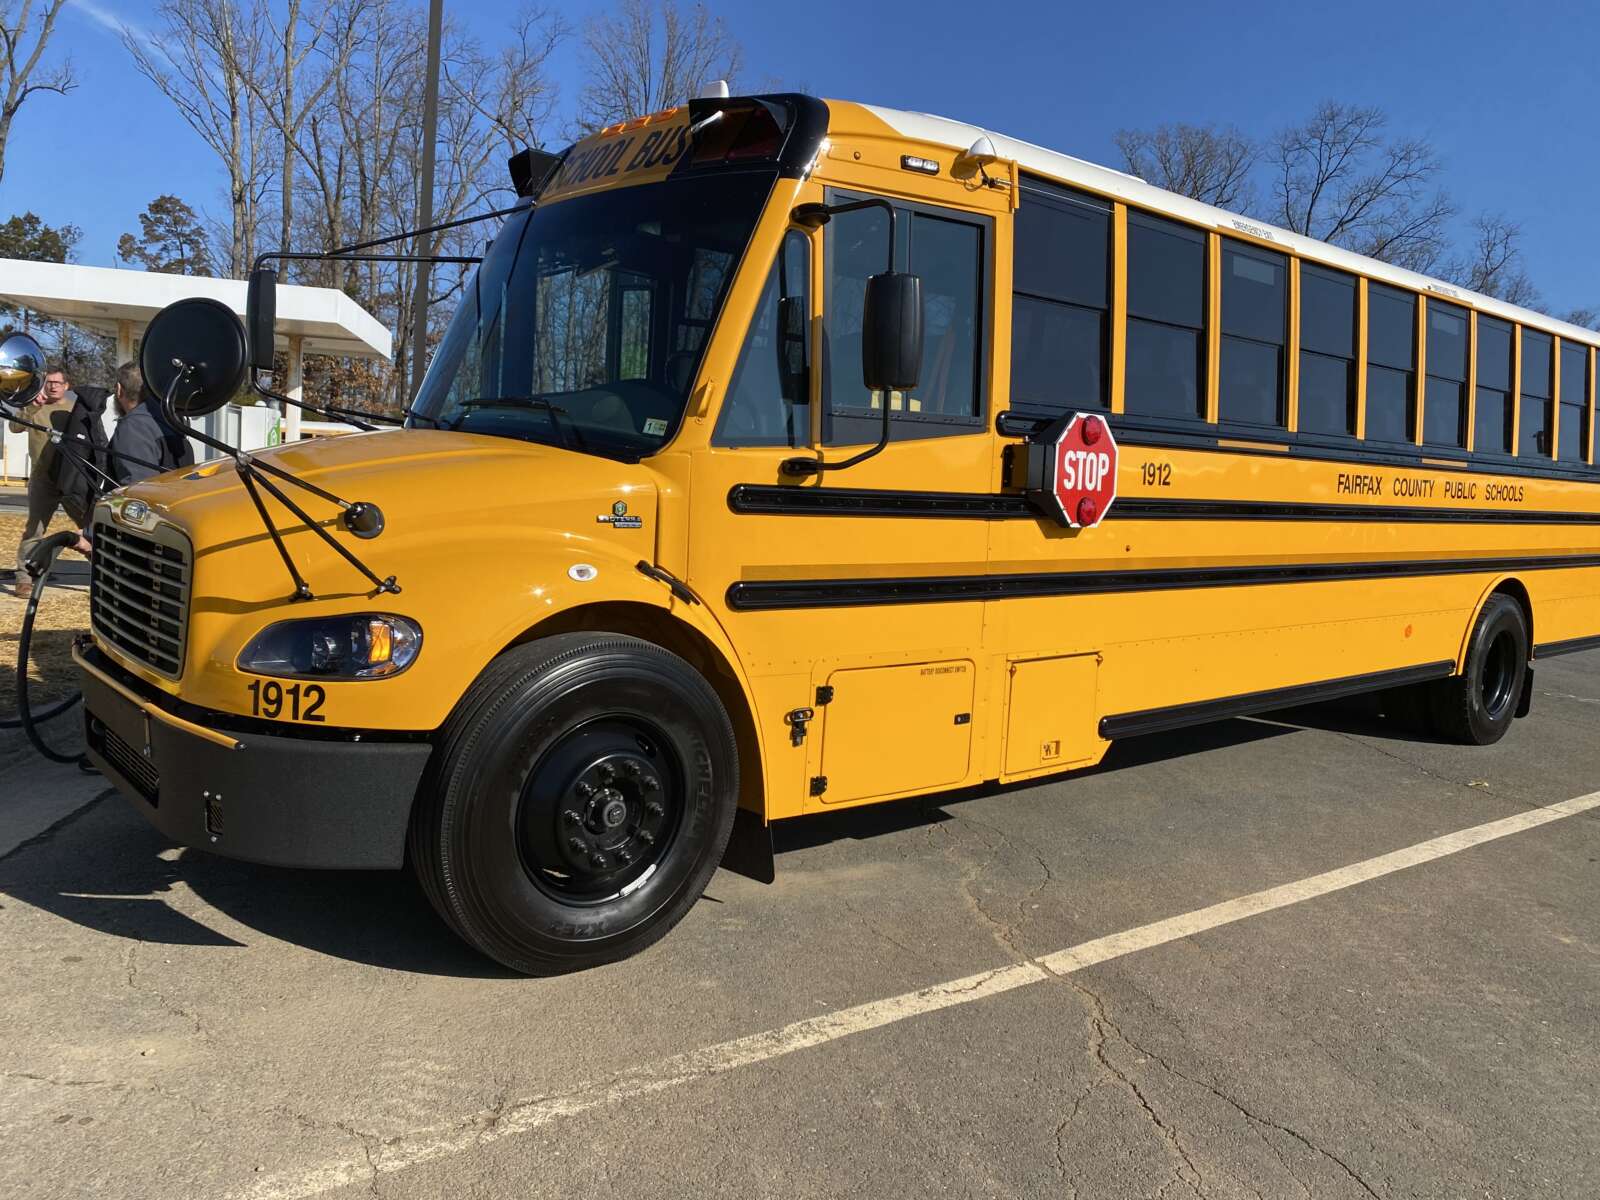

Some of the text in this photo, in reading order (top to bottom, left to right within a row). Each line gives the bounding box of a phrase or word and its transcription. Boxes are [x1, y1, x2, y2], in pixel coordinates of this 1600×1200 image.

[624, 124, 693, 172] BUS
[1063, 449, 1110, 492] STOP
[1141, 462, 1172, 486] 1912
[1337, 473, 1524, 502] FAIRFAX COUNTY PUBLIC SCHOOLS
[247, 679, 326, 722] 1912
